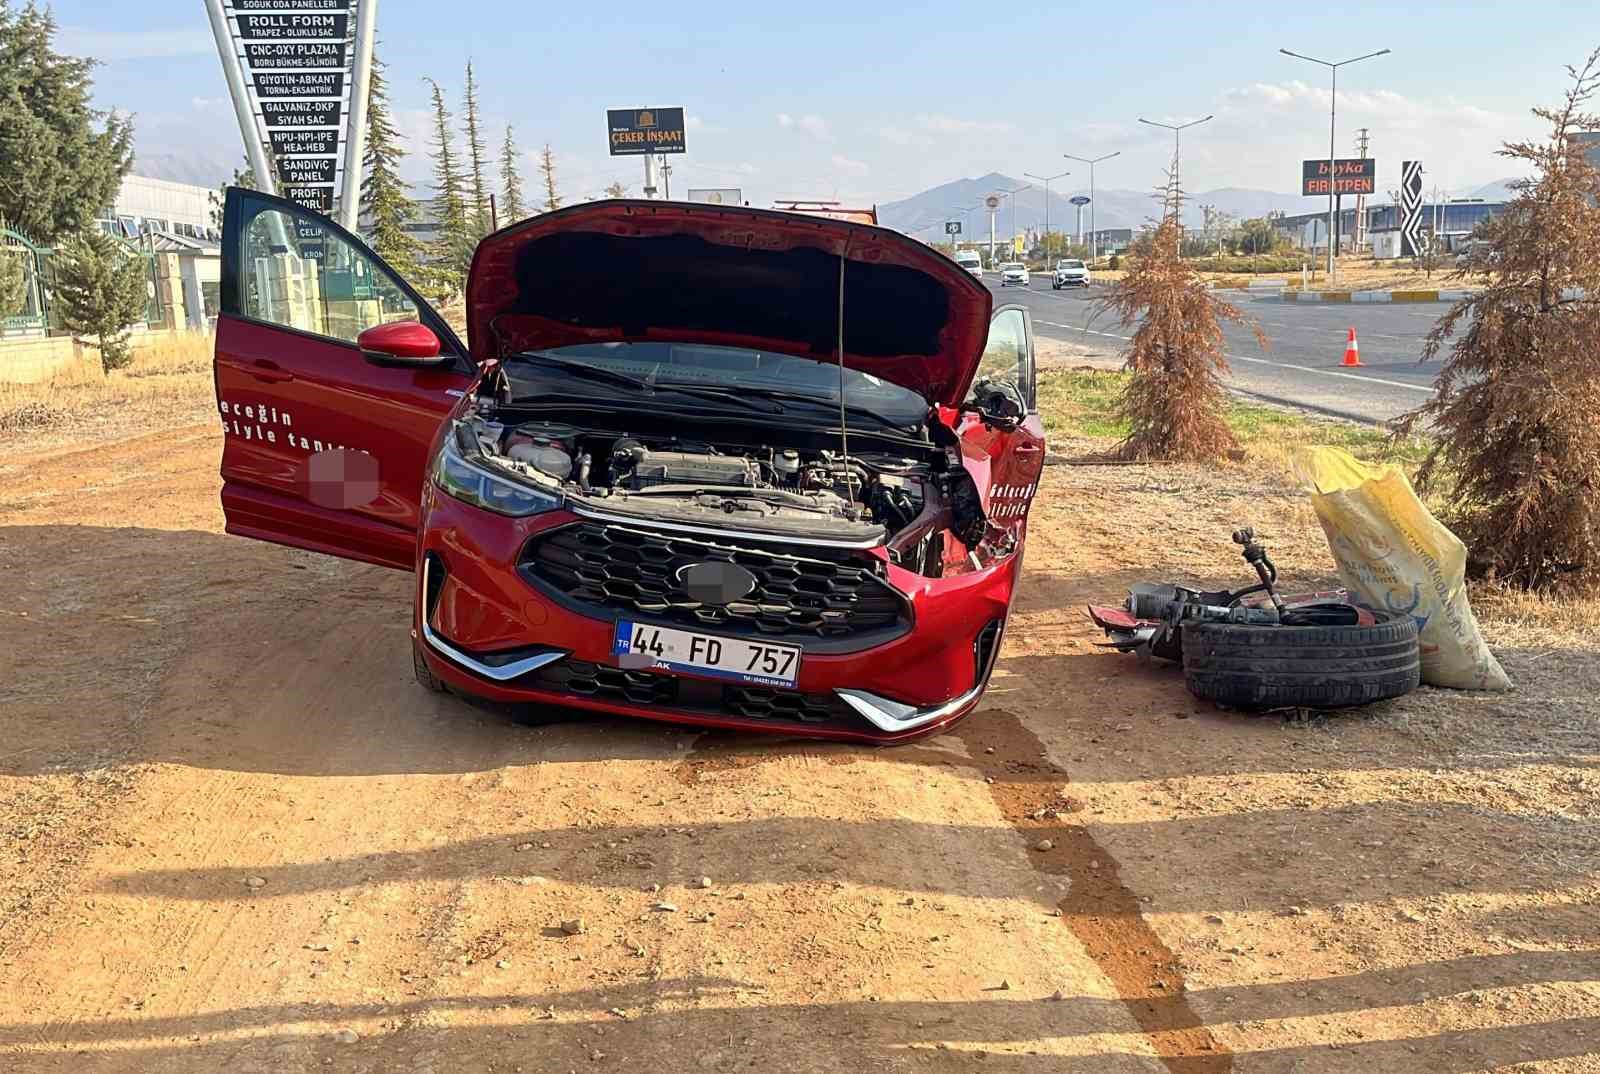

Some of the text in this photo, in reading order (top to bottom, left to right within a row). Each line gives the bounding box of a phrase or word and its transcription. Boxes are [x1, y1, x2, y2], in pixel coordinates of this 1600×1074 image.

[274, 0, 290, 8] ODA
[249, 16, 335, 26] ROLL FORM
[251, 29, 281, 37] TRAPEZ
[287, 29, 317, 37] OLUKLU
[318, 28, 334, 36] SAC
[251, 44, 338, 55] CNC-OXY PLAZMA
[254, 58, 275, 67] BORU
[259, 73, 336, 85] GİYOTİN-ABKANT
[266, 102, 334, 112] GALVANİZ-DKP
[278, 115, 325, 125] SİYAH SAC
[612, 129, 683, 145] ÇEKER İNŞAAT
[291, 171, 325, 181] PANEL
[617, 639, 630, 649] TR
[633, 627, 796, 677] 44 FD 757
